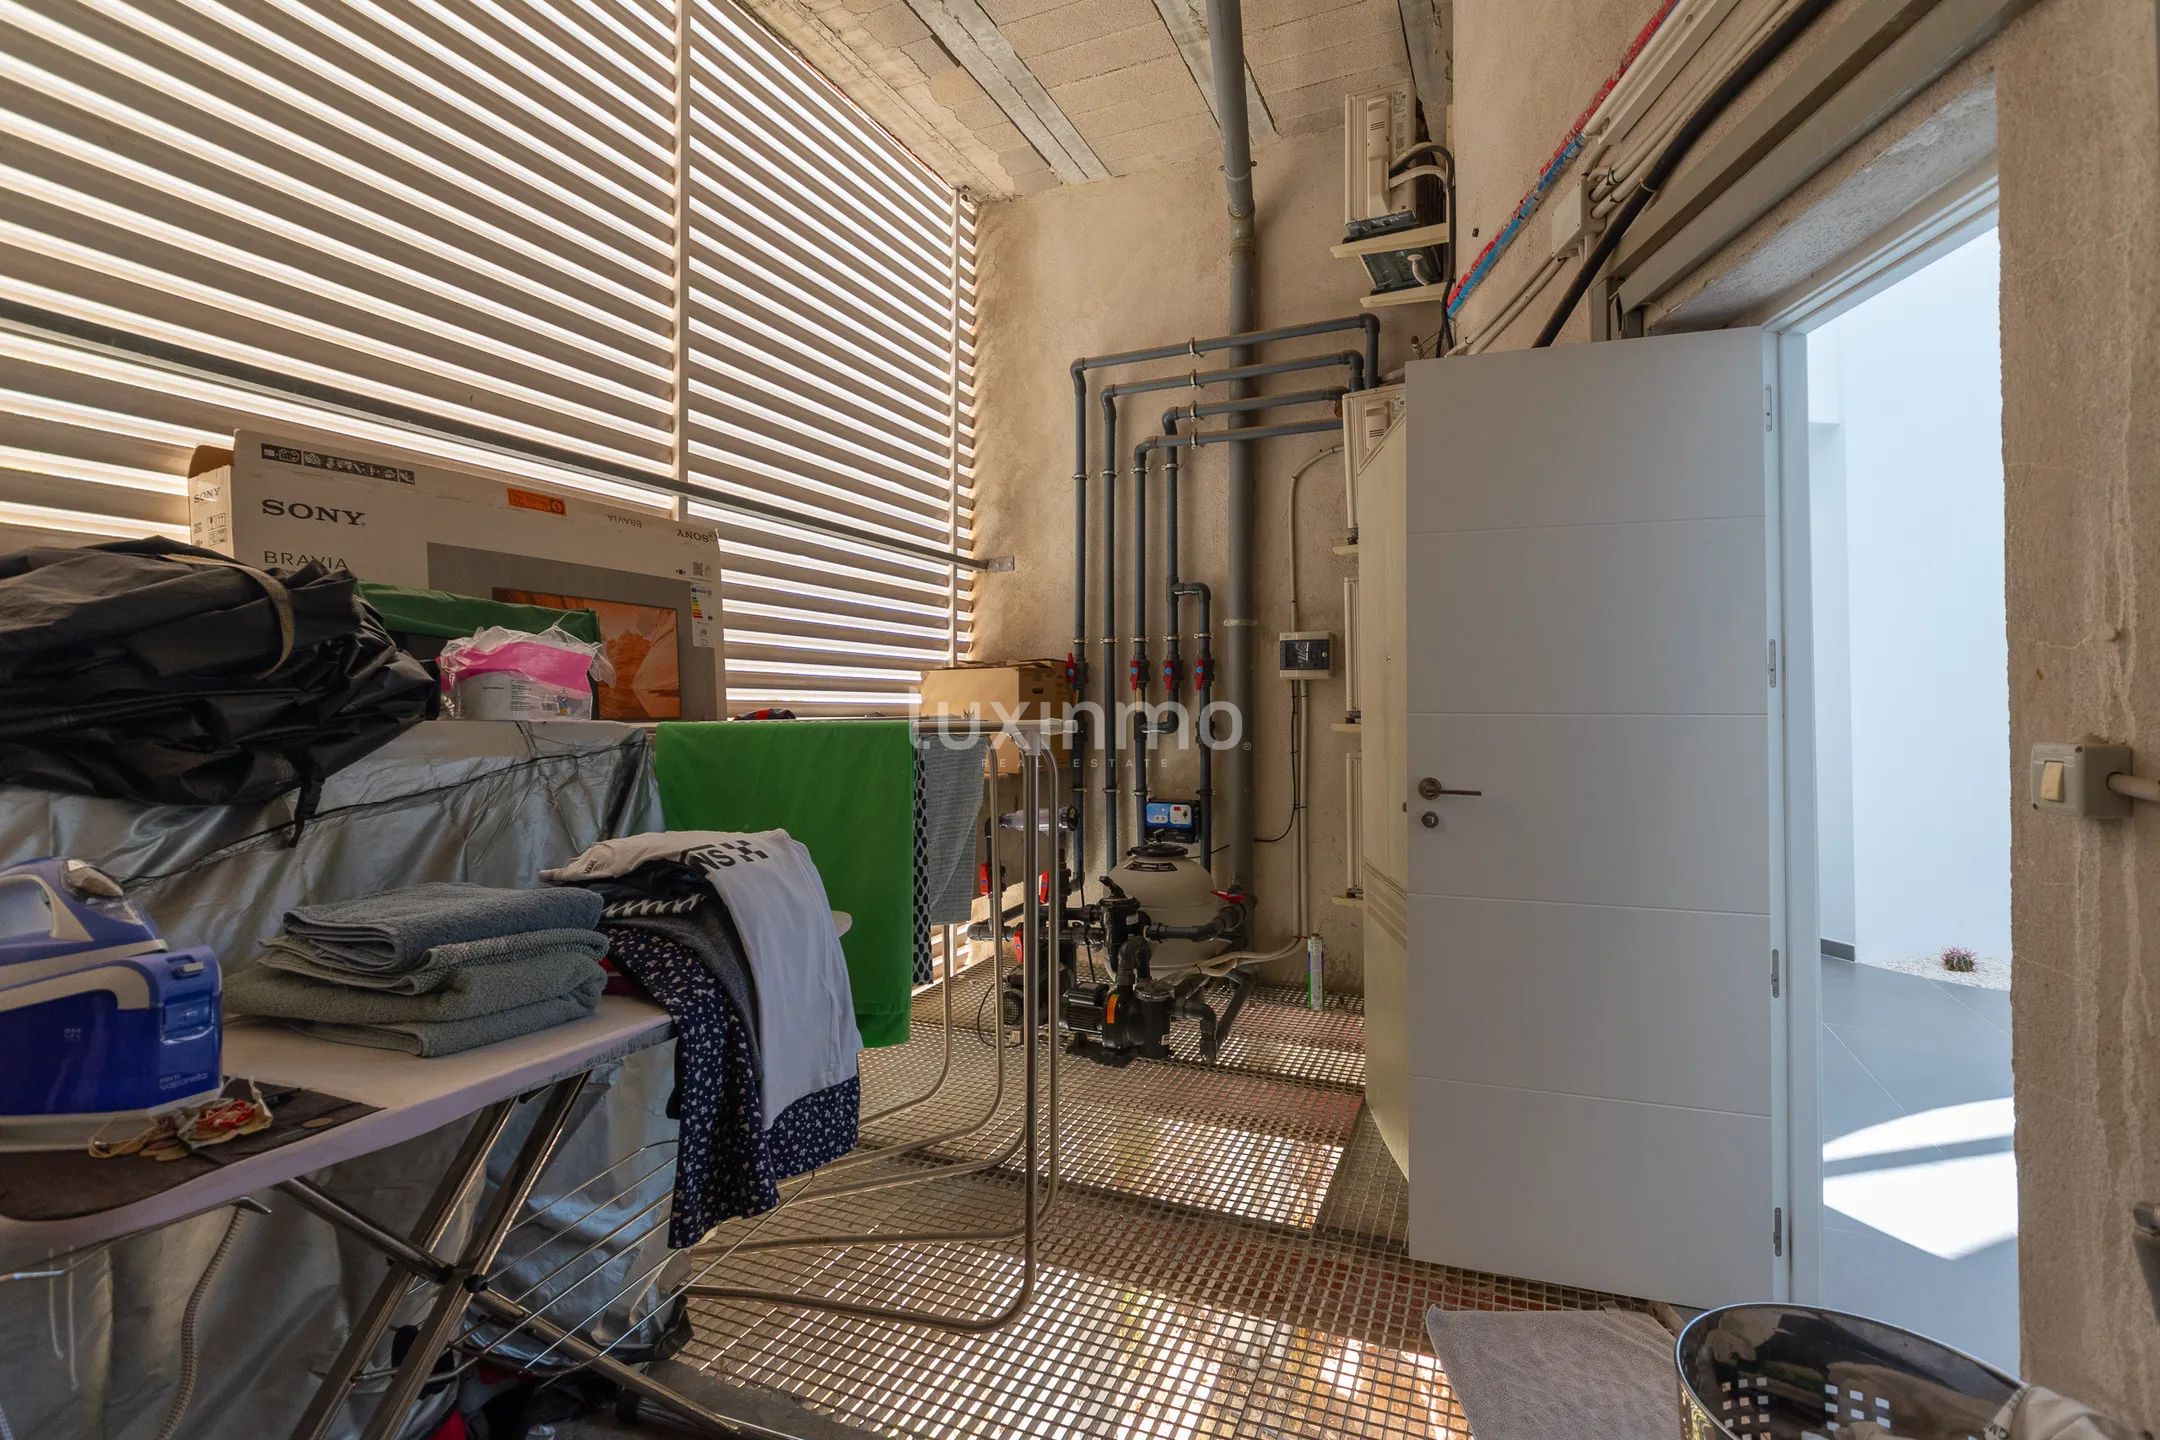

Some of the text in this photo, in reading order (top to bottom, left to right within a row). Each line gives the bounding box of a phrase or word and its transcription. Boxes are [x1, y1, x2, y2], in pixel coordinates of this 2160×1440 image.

[193, 486, 221, 504] SONY
[261, 499, 365, 527] SONY
[677, 528, 709, 543] SONY
